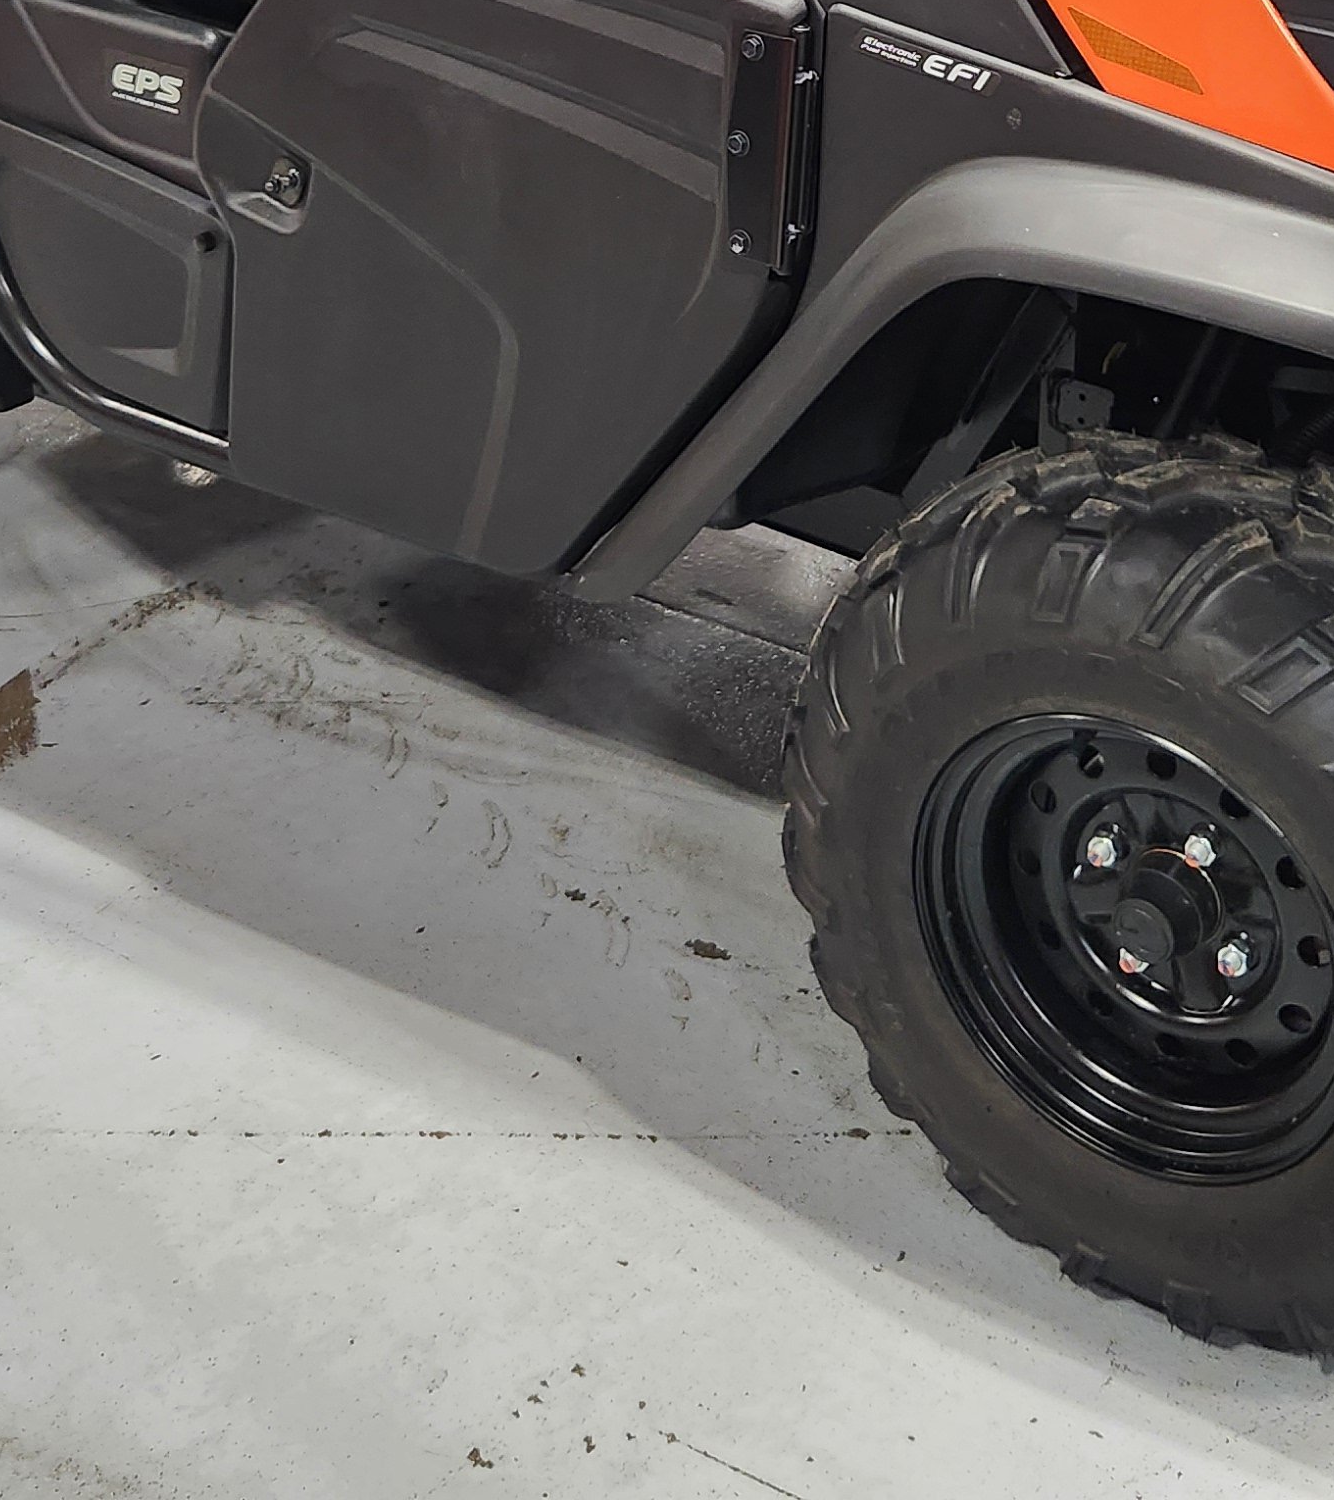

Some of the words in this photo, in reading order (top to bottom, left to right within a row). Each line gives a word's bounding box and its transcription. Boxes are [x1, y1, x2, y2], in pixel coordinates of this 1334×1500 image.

[863, 36, 922, 62] Electronic
[112, 63, 184, 104] EPS
[922, 54, 991, 91] EFI
